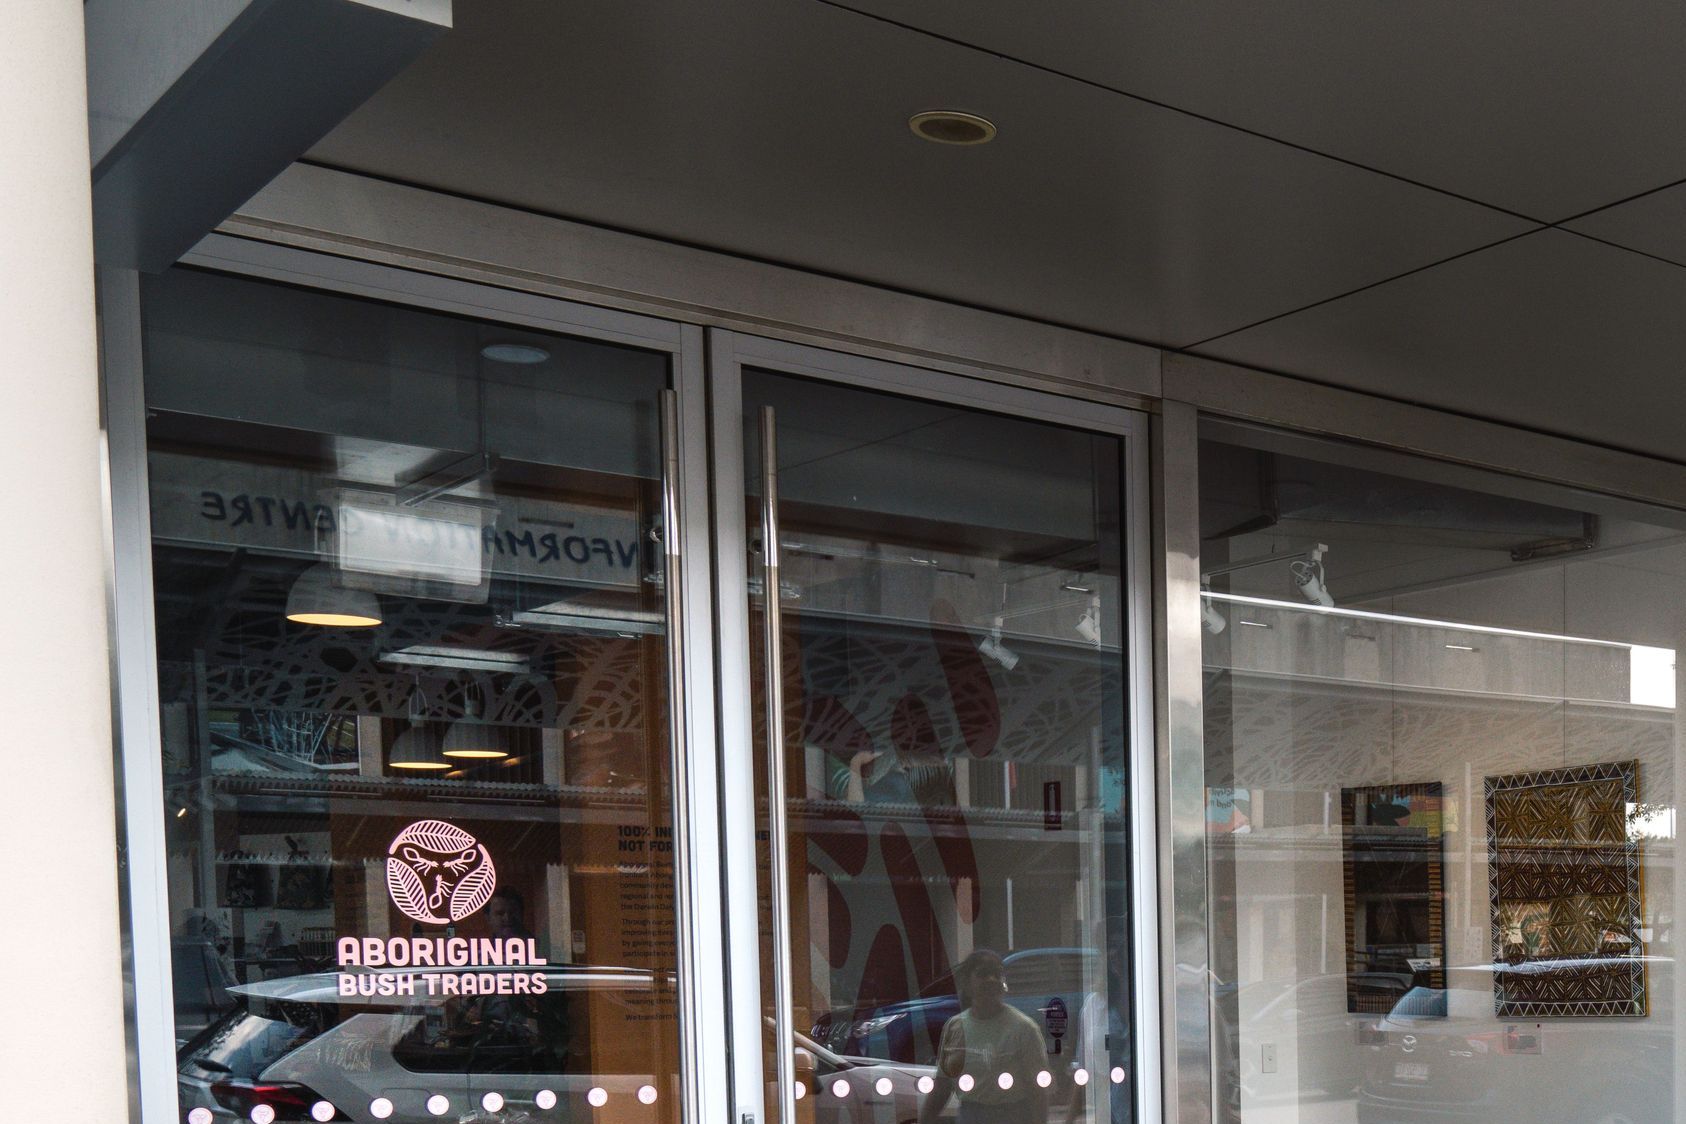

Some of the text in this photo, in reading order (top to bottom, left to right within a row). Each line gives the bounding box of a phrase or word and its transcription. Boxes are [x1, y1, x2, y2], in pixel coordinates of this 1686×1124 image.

[617, 825, 650, 838] 100%
[618, 840, 672, 852] NOT FOR
[338, 937, 547, 966] ABORIGINAL
[339, 972, 548, 996] BUSH TRADERS
